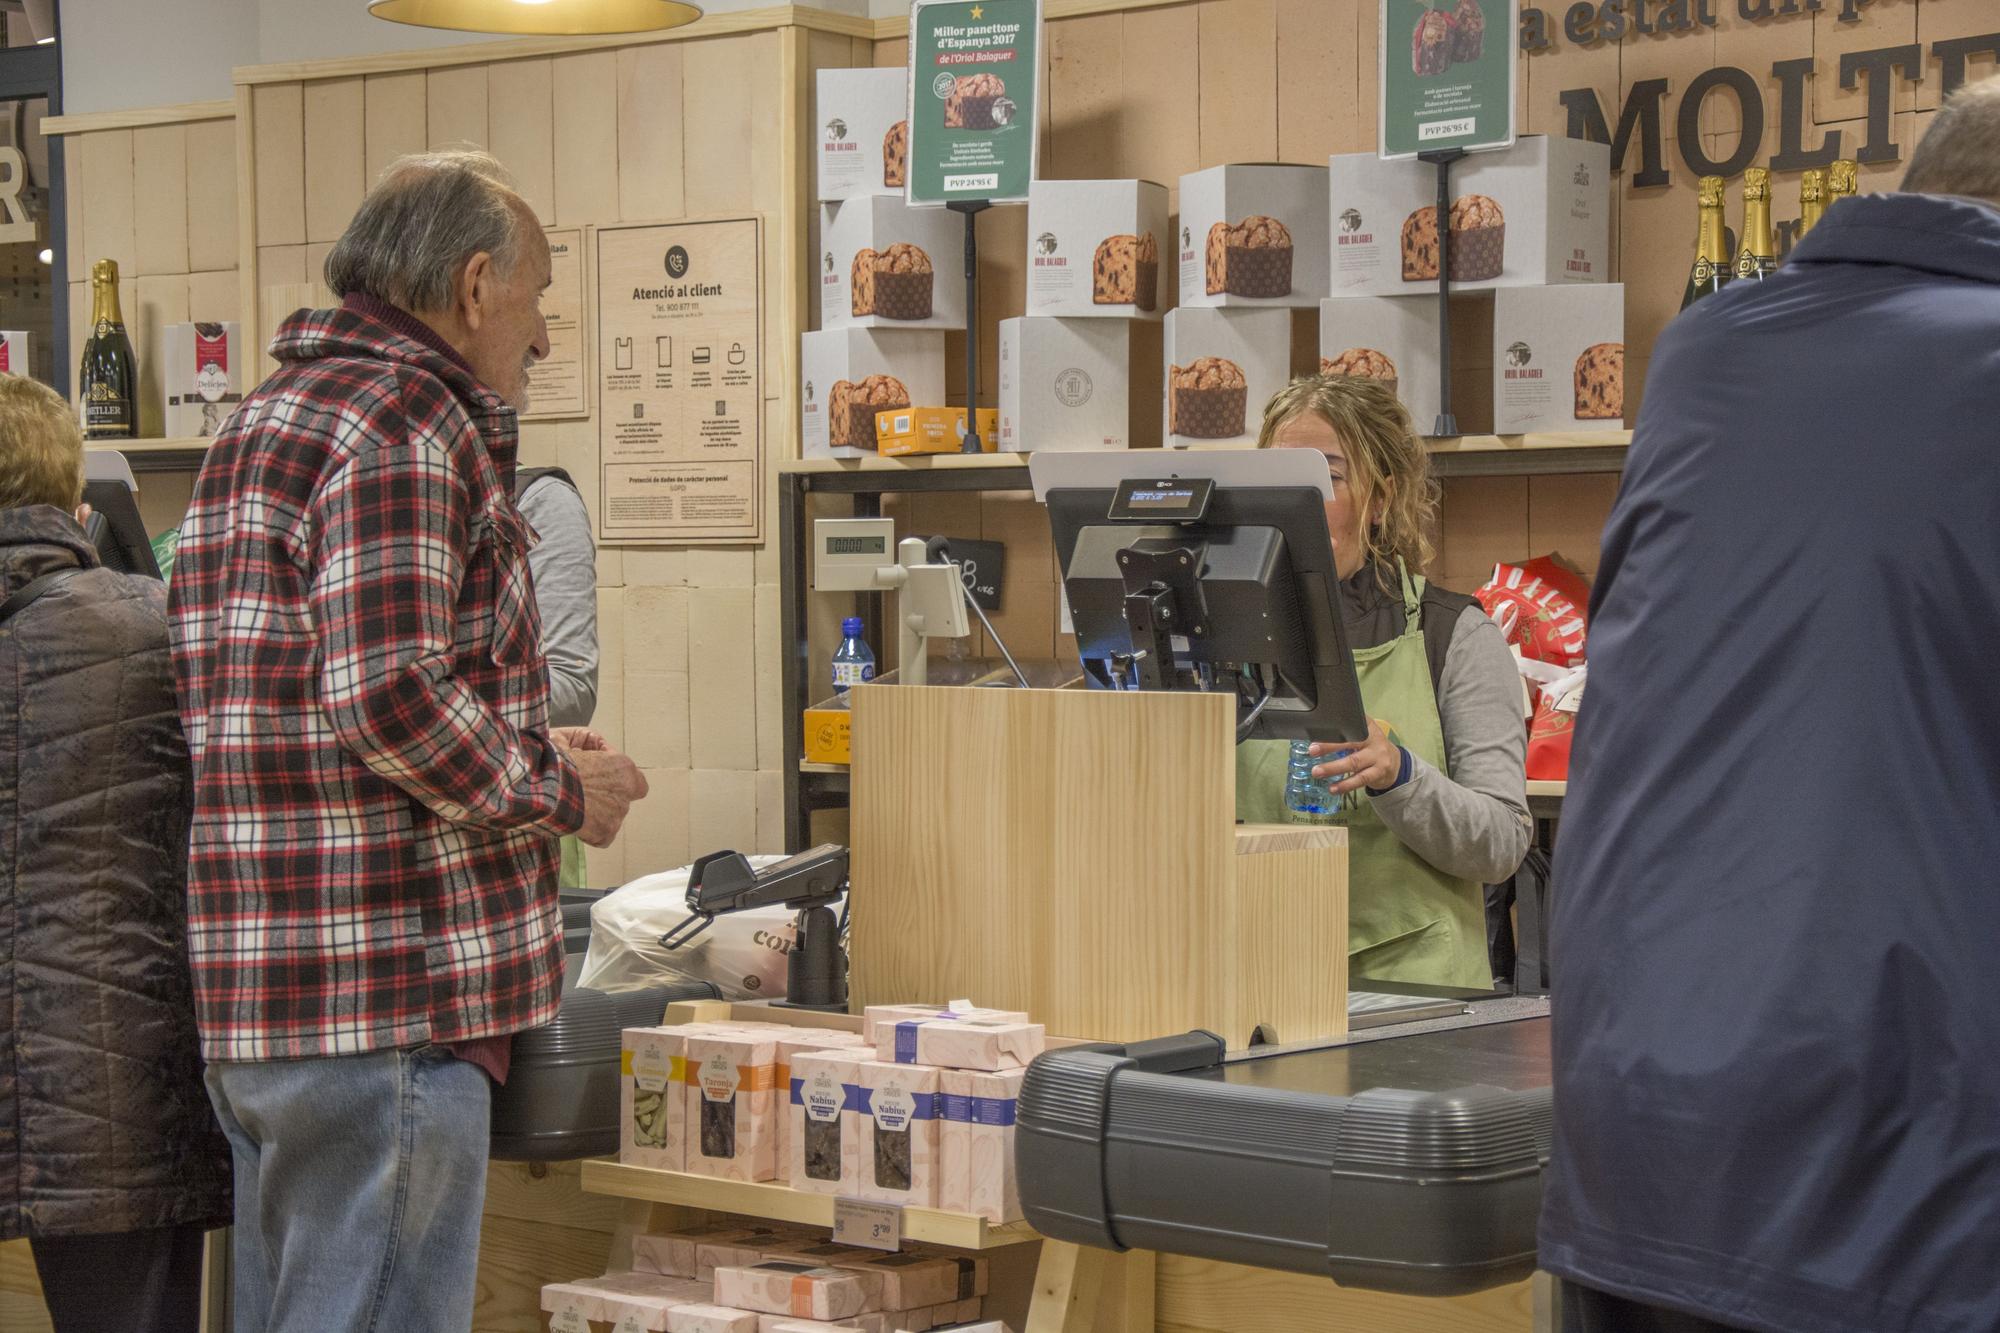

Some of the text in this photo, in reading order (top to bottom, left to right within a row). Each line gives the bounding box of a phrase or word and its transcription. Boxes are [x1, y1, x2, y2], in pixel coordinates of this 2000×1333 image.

[933, 23, 1020, 37] Millor panettone
[937, 34, 1015, 49] d'Espanya 2017
[940, 51, 1012, 64] de l'Oriol Balaguer
[1425, 126, 1440, 135] PVP
[1442, 123, 1462, 133] 26'95
[950, 179, 965, 187] PVP
[632, 283, 722, 300] Atenció al client
[656, 304, 665, 312] Tel.
[667, 303, 678, 312] 900
[704, 1077, 733, 1088] Taronja
[809, 1095, 836, 1105] Nabius
[879, 1105, 906, 1116] Nabius
